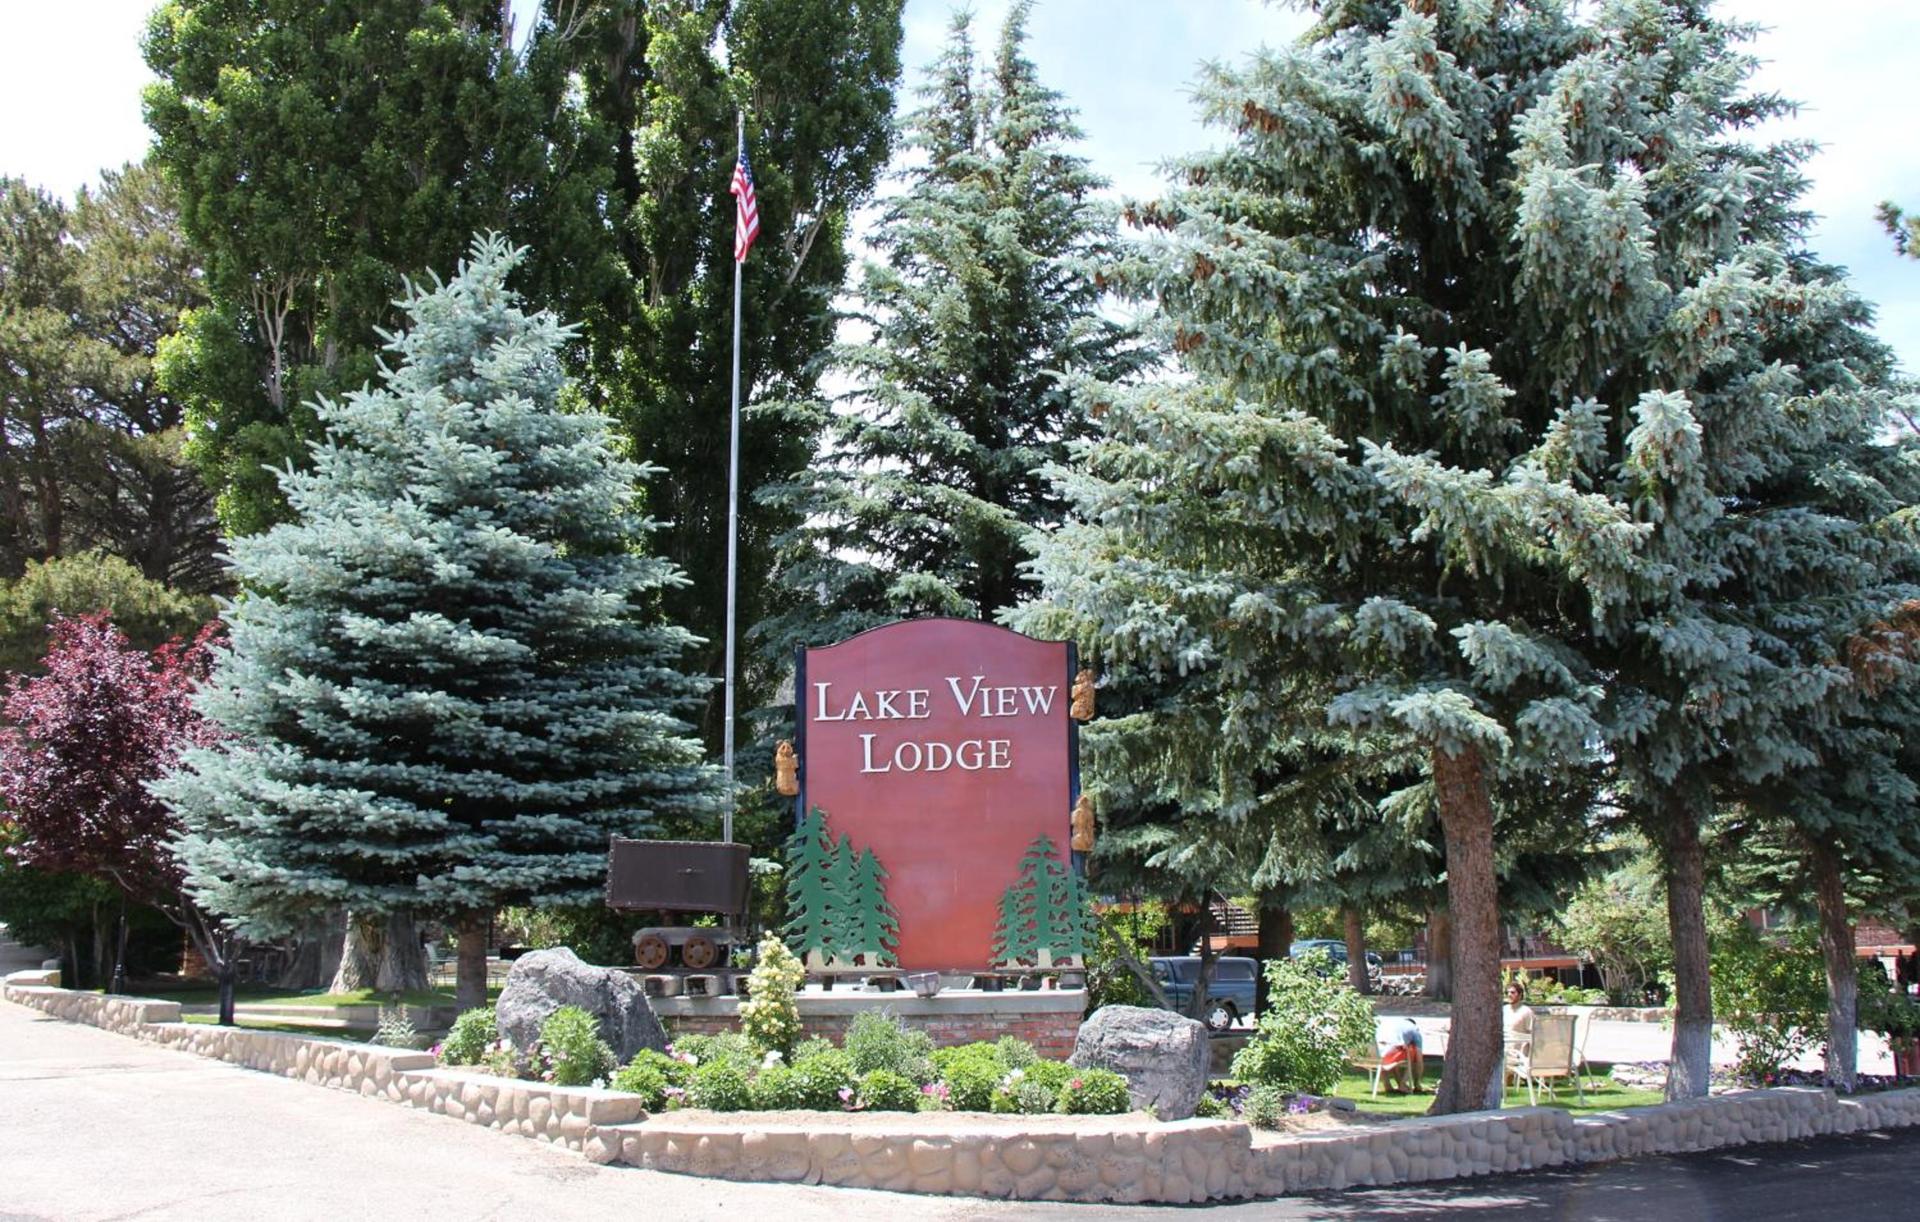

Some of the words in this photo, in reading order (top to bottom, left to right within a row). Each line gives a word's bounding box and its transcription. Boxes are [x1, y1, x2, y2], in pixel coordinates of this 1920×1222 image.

[813, 682, 931, 721] LAKE
[945, 676, 1058, 717] VIEW
[858, 733, 1012, 773] LODGE
